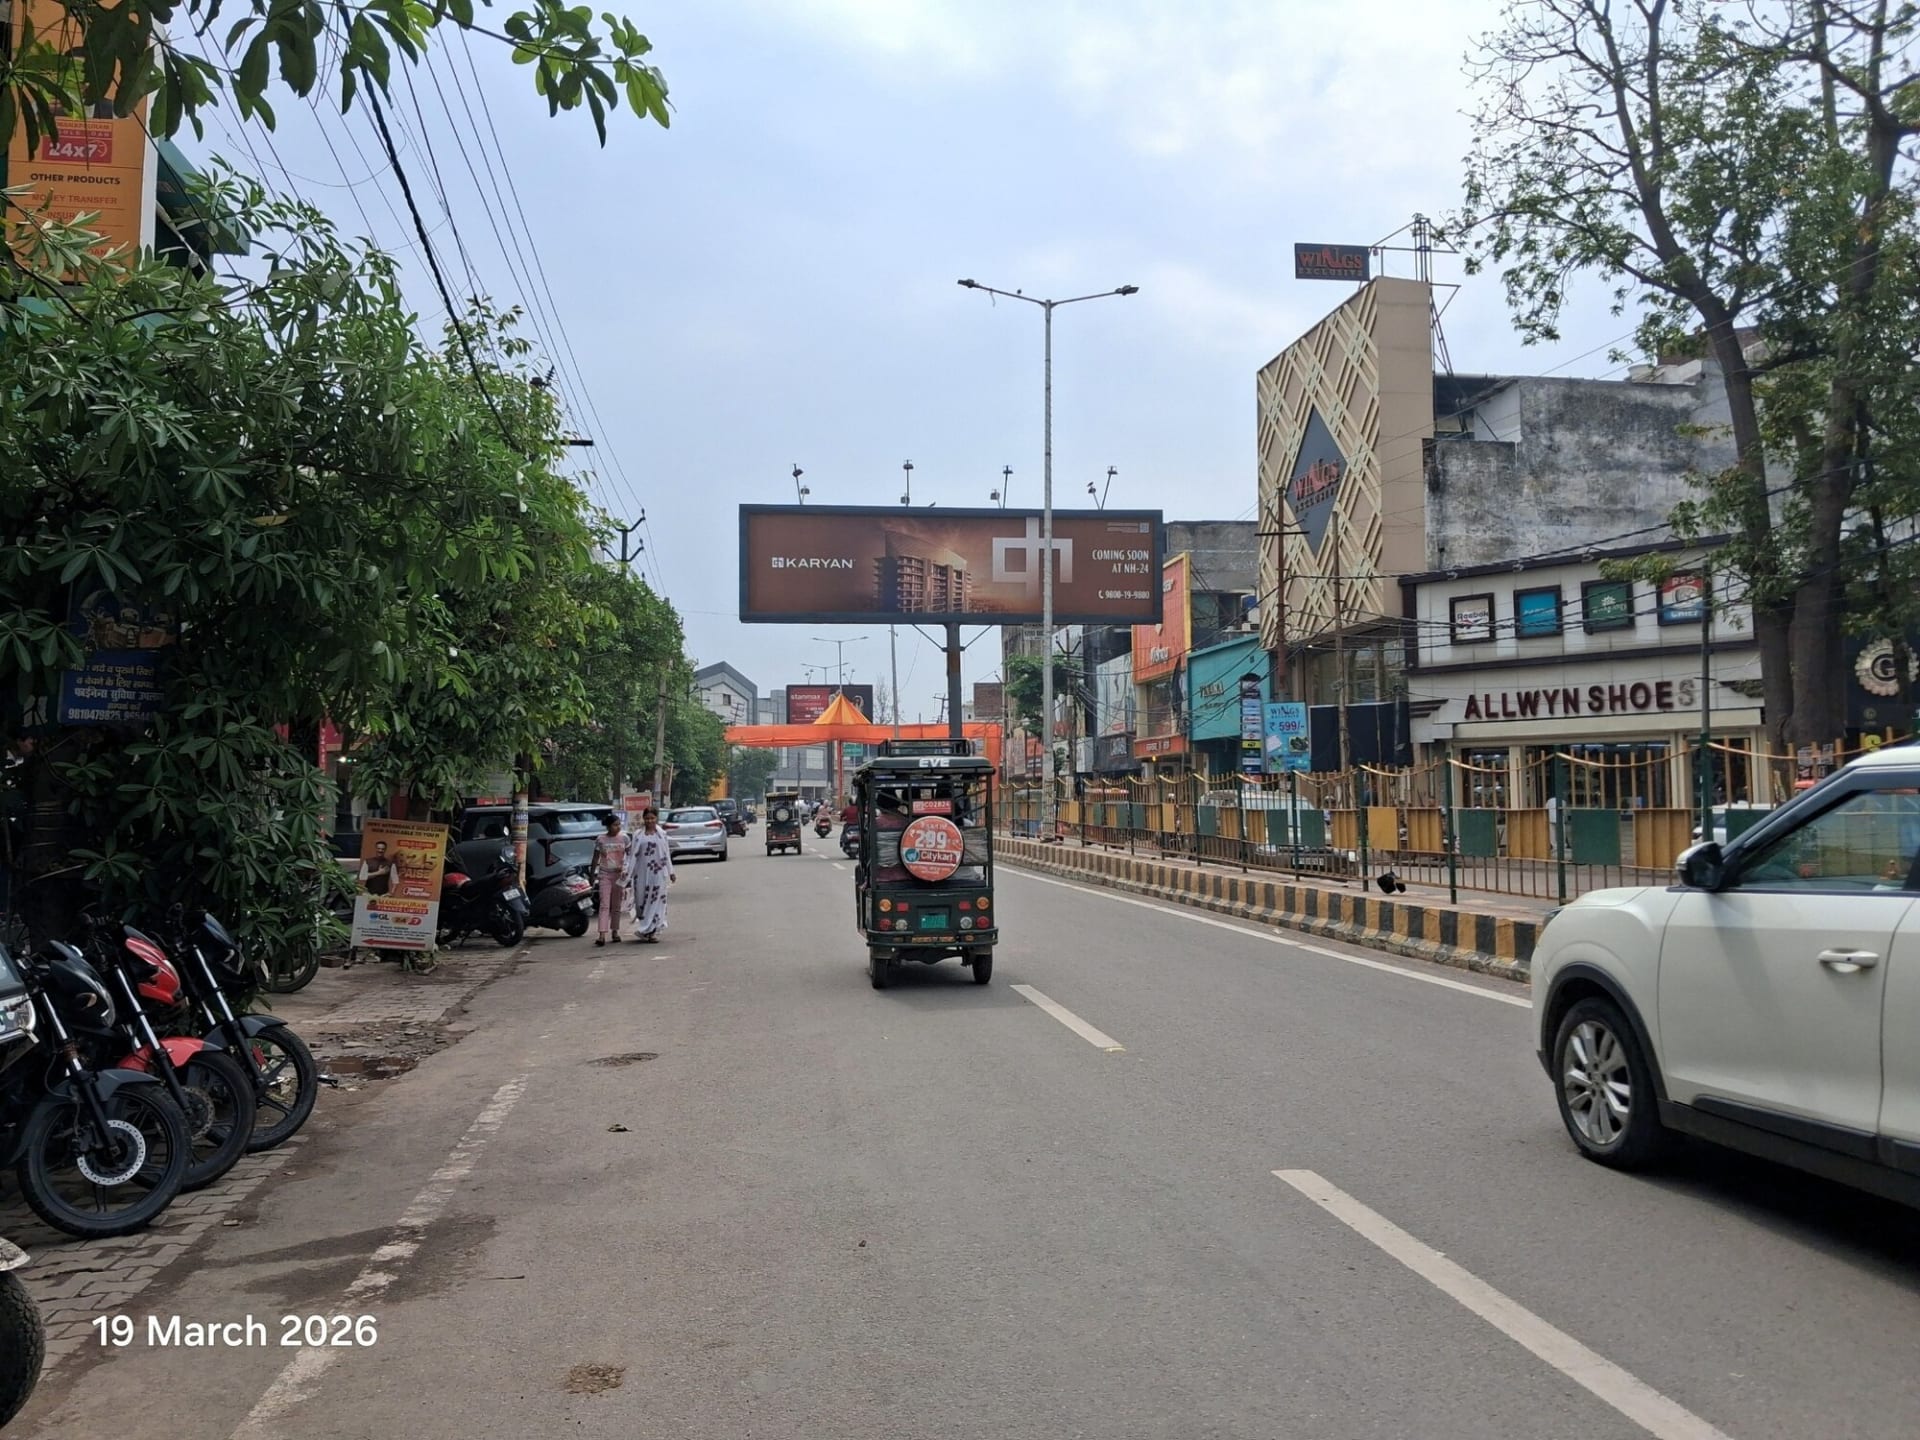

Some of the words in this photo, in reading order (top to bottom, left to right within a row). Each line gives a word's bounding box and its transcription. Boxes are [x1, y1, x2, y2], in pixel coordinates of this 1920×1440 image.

[49, 142, 97, 158] 24x7
[30, 173, 64, 182] OTHER
[67, 175, 121, 185] PRODUCTS
[31, 193, 65, 203] MOEY
[69, 195, 118, 204] TRANSFER
[1299, 247, 1363, 268] WINGS
[1298, 267, 1363, 276] EXCLUSIVE
[1295, 459, 1340, 500] WINGS
[1092, 549, 1125, 560] COMING
[1127, 549, 1149, 560] SOON
[786, 557, 853, 569] KARYAN
[1112, 563, 1121, 573] AT
[1124, 563, 1149, 574] NH-24
[1456, 610, 1489, 621] Reebok
[1465, 687, 1580, 719] ALLWYN
[1588, 679, 1696, 713] SHOES
[1271, 706, 1300, 715] WINGS
[1279, 721, 1305, 732] 599/-
[919, 757, 950, 768] EVE
[915, 831, 948, 849] 299
[920, 850, 954, 862] Citykart
[399, 868, 431, 880] PAISE
